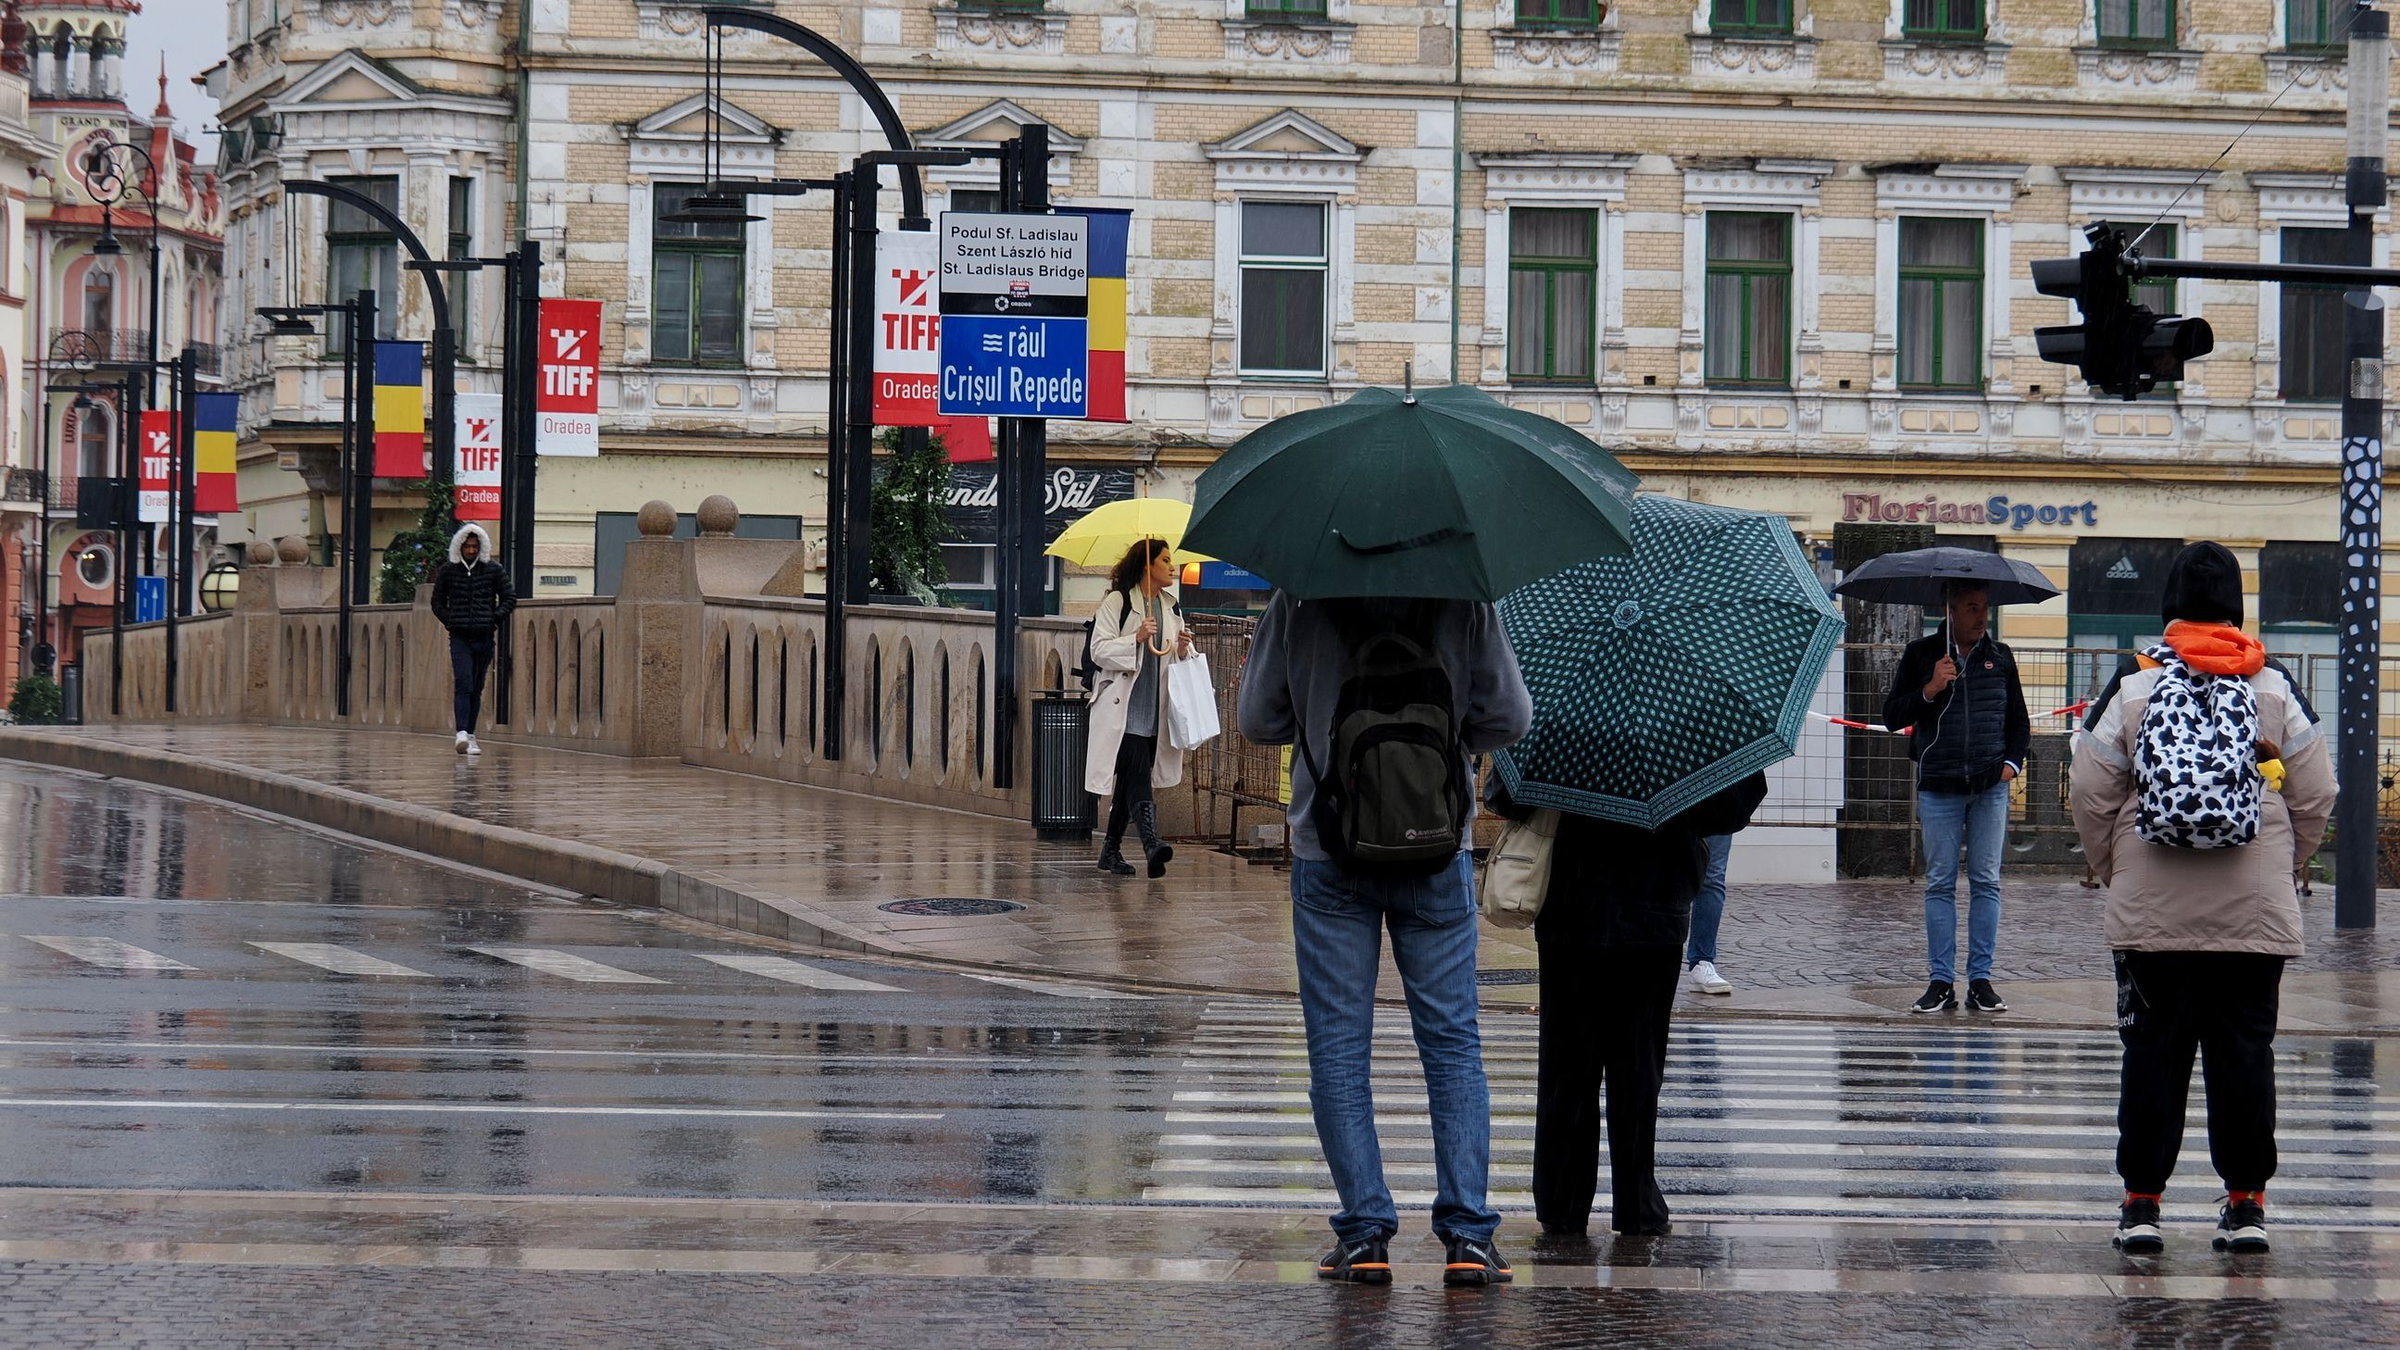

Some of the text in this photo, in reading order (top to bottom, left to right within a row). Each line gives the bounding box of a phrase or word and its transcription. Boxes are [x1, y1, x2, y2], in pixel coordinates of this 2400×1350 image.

[60, 116, 101, 127] GRAND
[951, 226, 1079, 242] Podul Sf. Ladislau
[957, 244, 1072, 260] Szent László híd
[943, 262, 1085, 280] St. Ladislaus Bridge
[882, 313, 940, 351] TIFF
[1008, 322, 1046, 358] râul
[542, 364, 594, 397] TIFF
[944, 365, 1083, 412] Crișul Repede
[544, 417, 592, 435] Oradea
[460, 447, 500, 472] TIFF
[460, 488, 500, 504] Oradea
[1045, 467, 1101, 515] Stil
[2105, 569, 2139, 579] adidas
